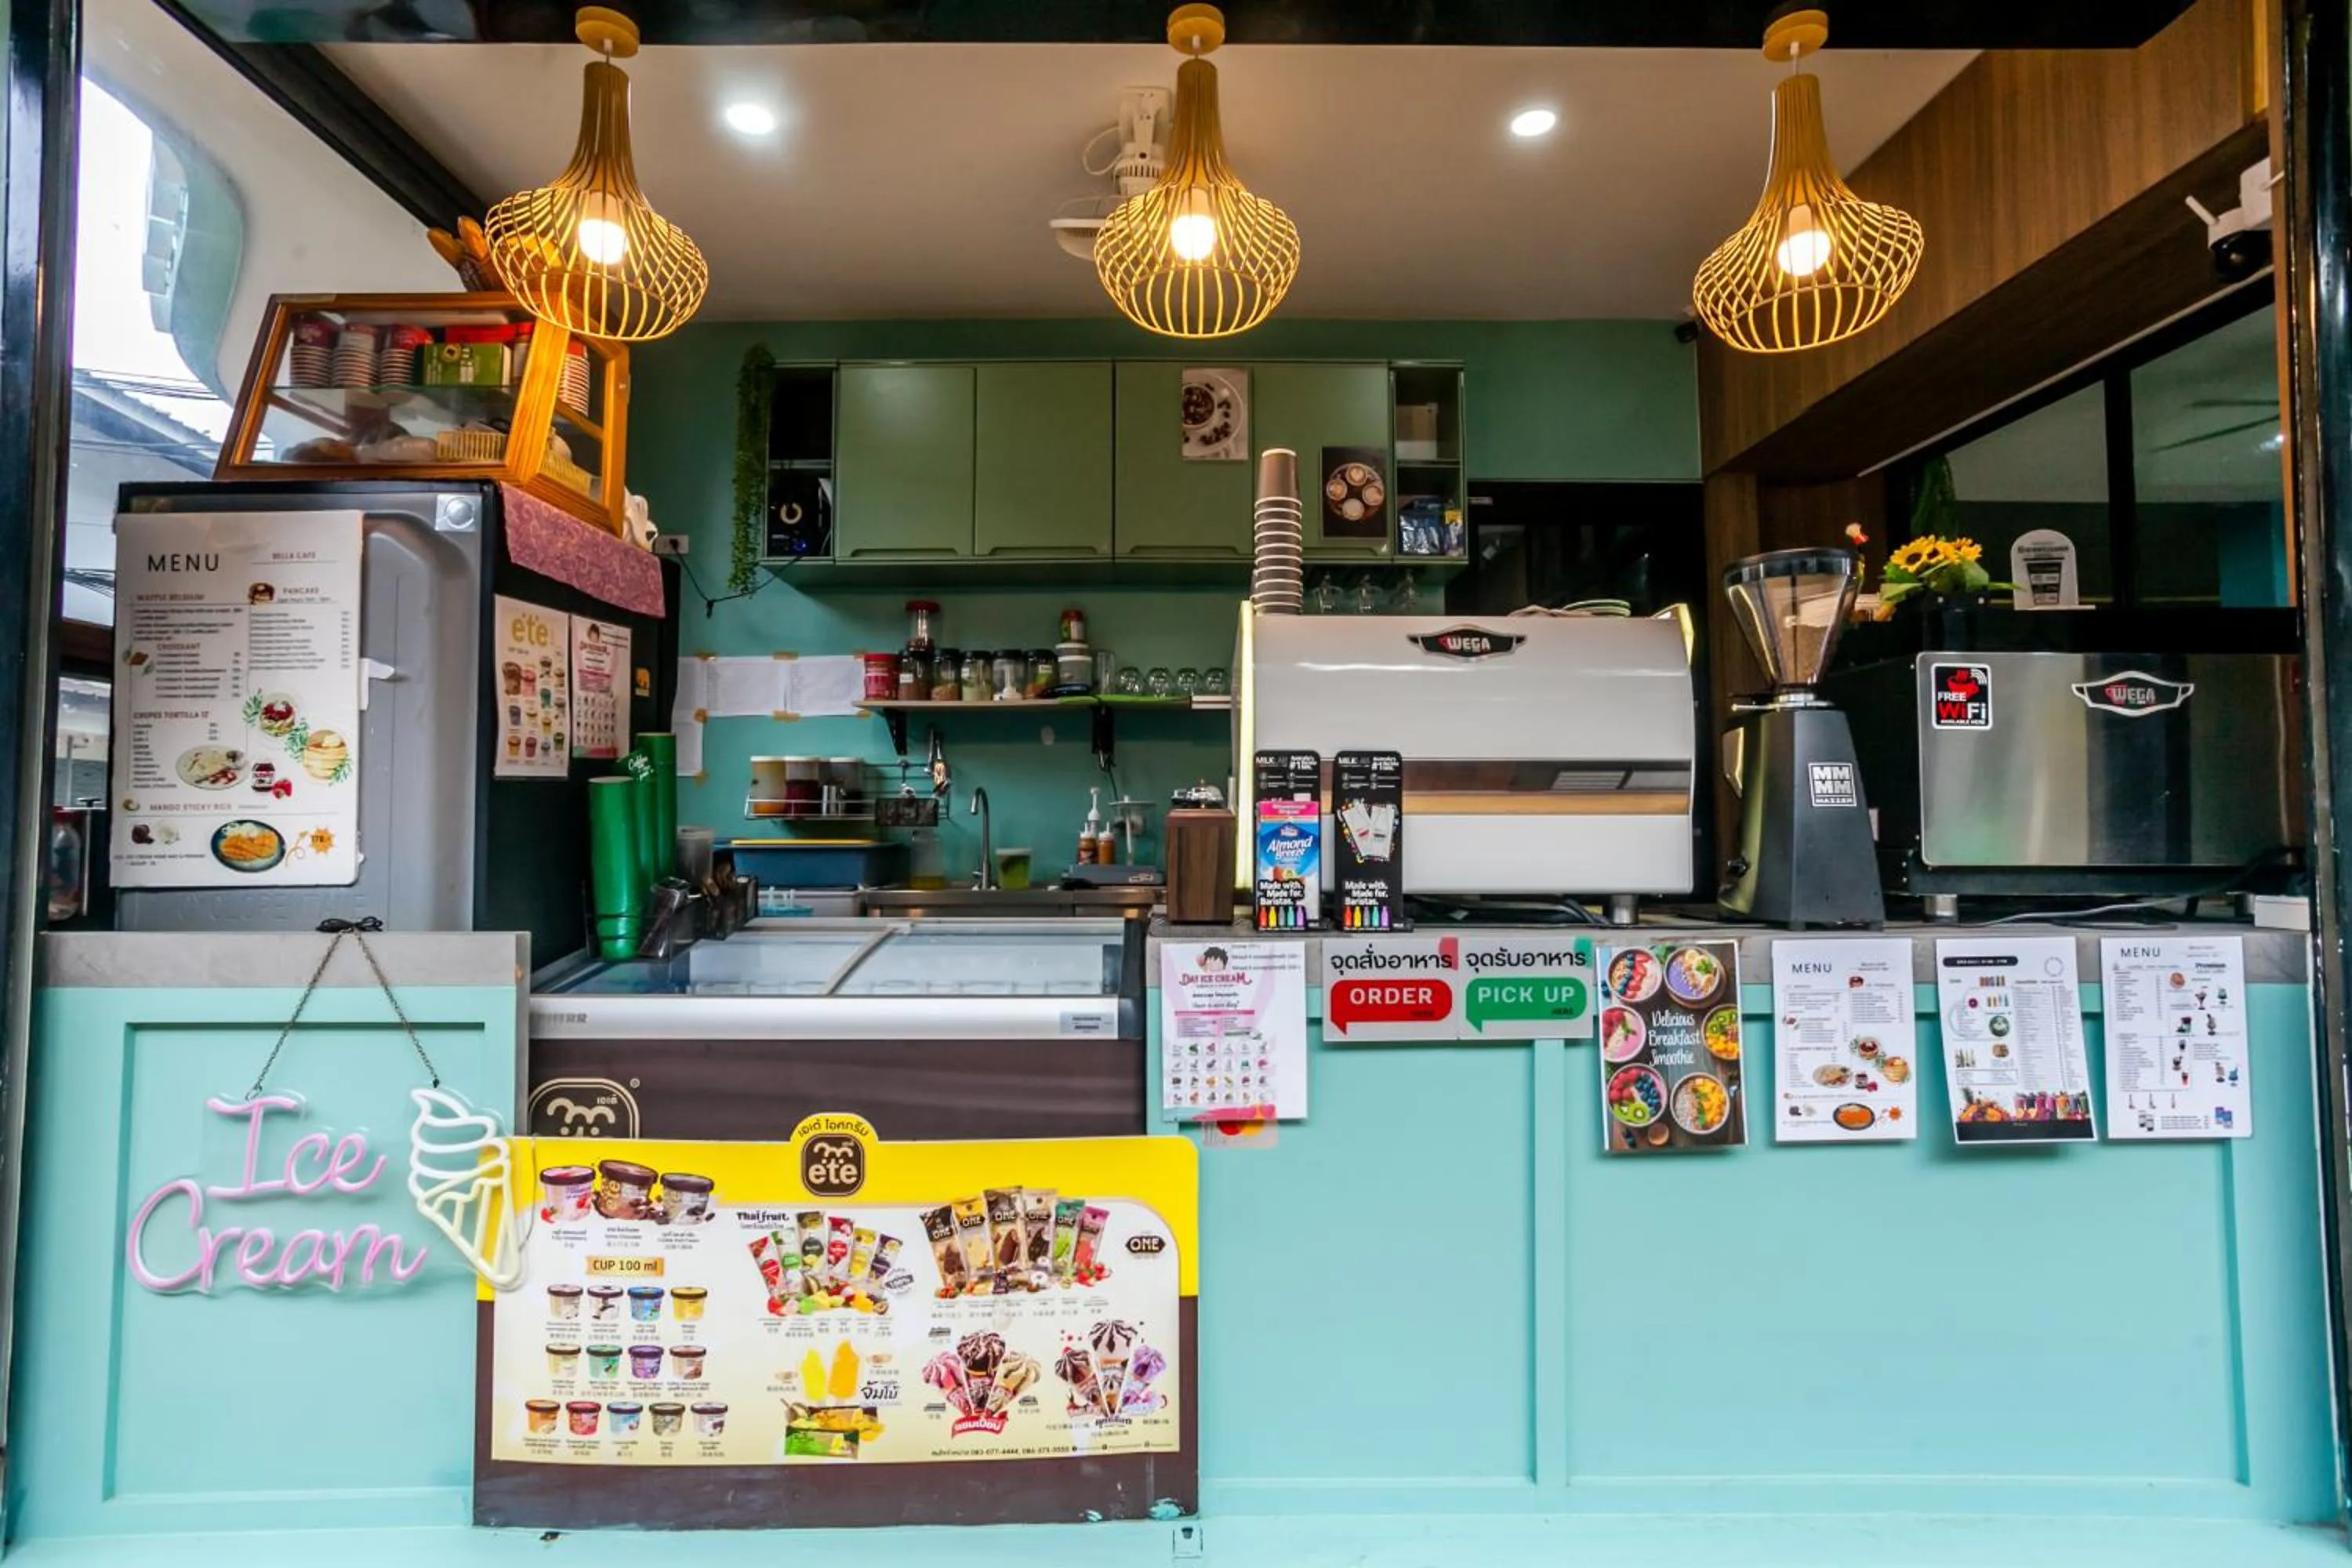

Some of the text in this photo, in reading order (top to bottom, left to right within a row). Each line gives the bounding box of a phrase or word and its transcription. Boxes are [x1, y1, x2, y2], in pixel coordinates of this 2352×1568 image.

[147, 554, 219, 572] MENU
[1446, 636, 1490, 652] WEGA
[1937, 691, 1966, 702] FREE
[2111, 684, 2155, 704] WEGA
[1936, 702, 1986, 719] WiFi
[1266, 835, 1313, 853] Almond
[1330, 944, 1452, 975] จุดสั่งอาหาร
[1466, 947, 1586, 973] จุดรับอาหาร
[2120, 947, 2161, 957] MENU
[1791, 964, 1832, 974] MENU
[1349, 988, 1432, 1004] ORDER
[1478, 986, 1575, 1003] PICK UP
[1652, 1010, 1695, 1027] Delicious
[1648, 1031, 1700, 1047] Breakfast
[1649, 1051, 1694, 1066] Smoothie
[206, 1097, 387, 1200] Ice
[995, 1210, 1016, 1221] ONE
[127, 1179, 428, 1290] Cream
[1131, 1238, 1160, 1250] ONE
[593, 1260, 658, 1271] CUP 100 ml
